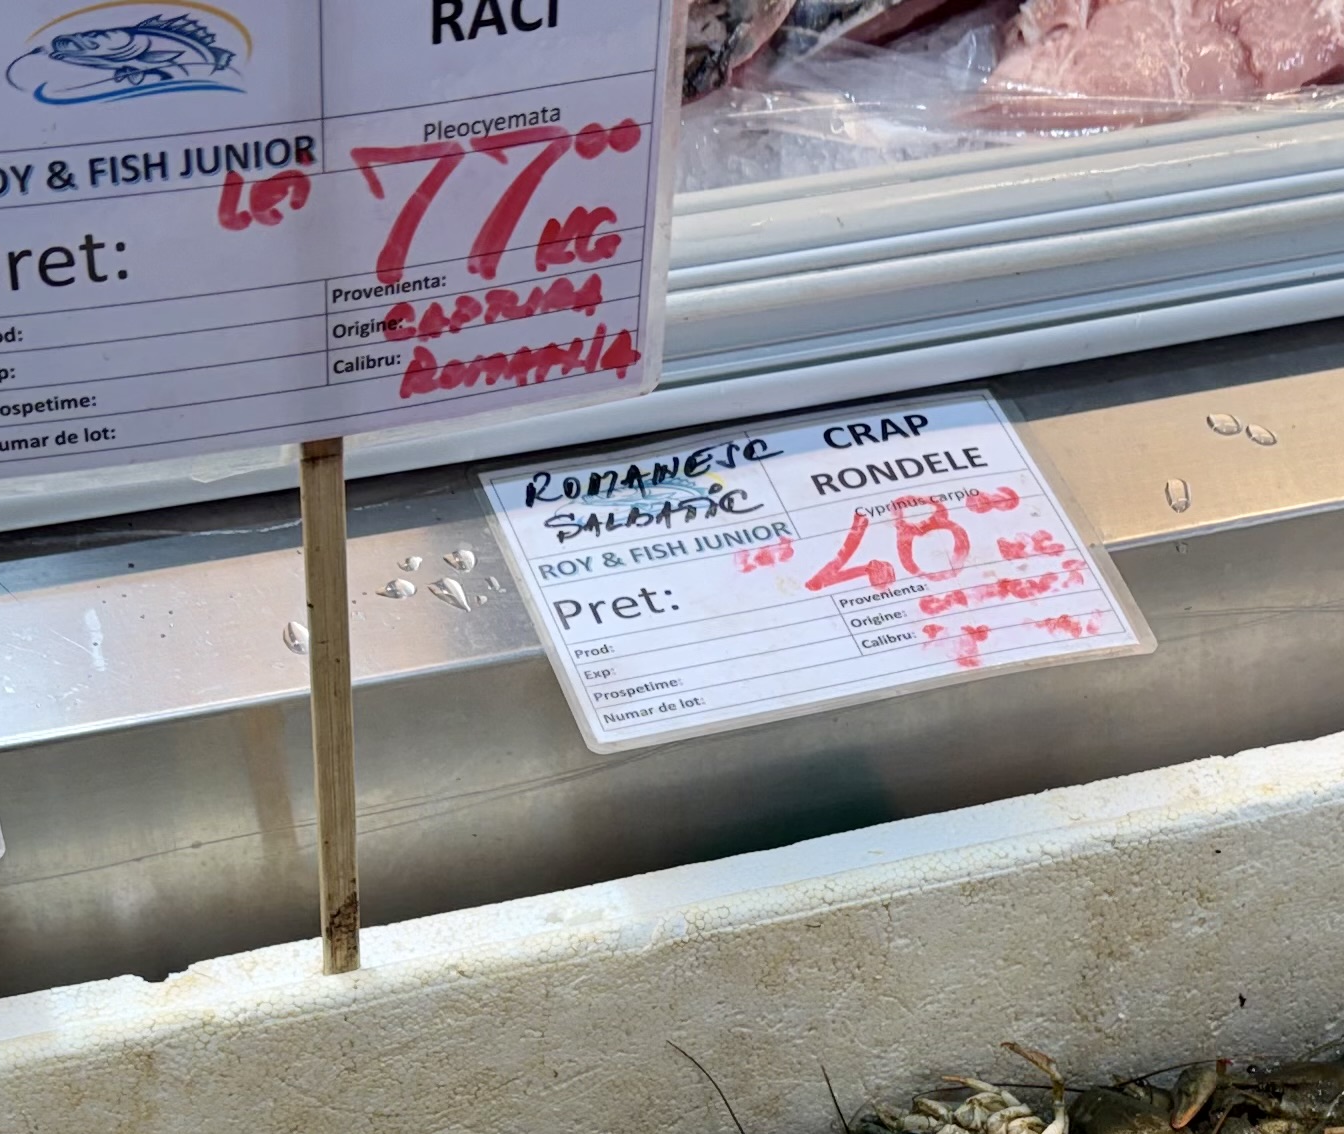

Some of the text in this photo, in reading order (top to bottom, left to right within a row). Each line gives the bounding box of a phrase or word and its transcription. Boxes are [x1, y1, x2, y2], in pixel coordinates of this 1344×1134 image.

[424, 105, 561, 142] Pleocyemata
[47, 160, 75, 190] &
[89, 151, 168, 187] FISH
[180, 135, 316, 178] JUNIOR
[332, 275, 447, 304] Provenienta:
[333, 353, 401, 375] Calibru:
[55, 430, 78, 446] de
[83, 427, 117, 443] lot:
[823, 413, 929, 450] CRAP
[811, 447, 988, 496] RONDELE
[854, 486, 980, 520] Cyprinus carpio
[538, 520, 794, 581] ROY & FISH JUNIOR
[552, 586, 681, 631] Pret:
[839, 582, 929, 609] Provenienta:
[850, 609, 907, 631] Origine:
[573, 643, 616, 660] Prod:
[860, 630, 917, 651] Calibru:
[583, 666, 617, 681] Exp:
[592, 677, 684, 703] Prospetime:
[602, 695, 706, 725] Numar de lot:
